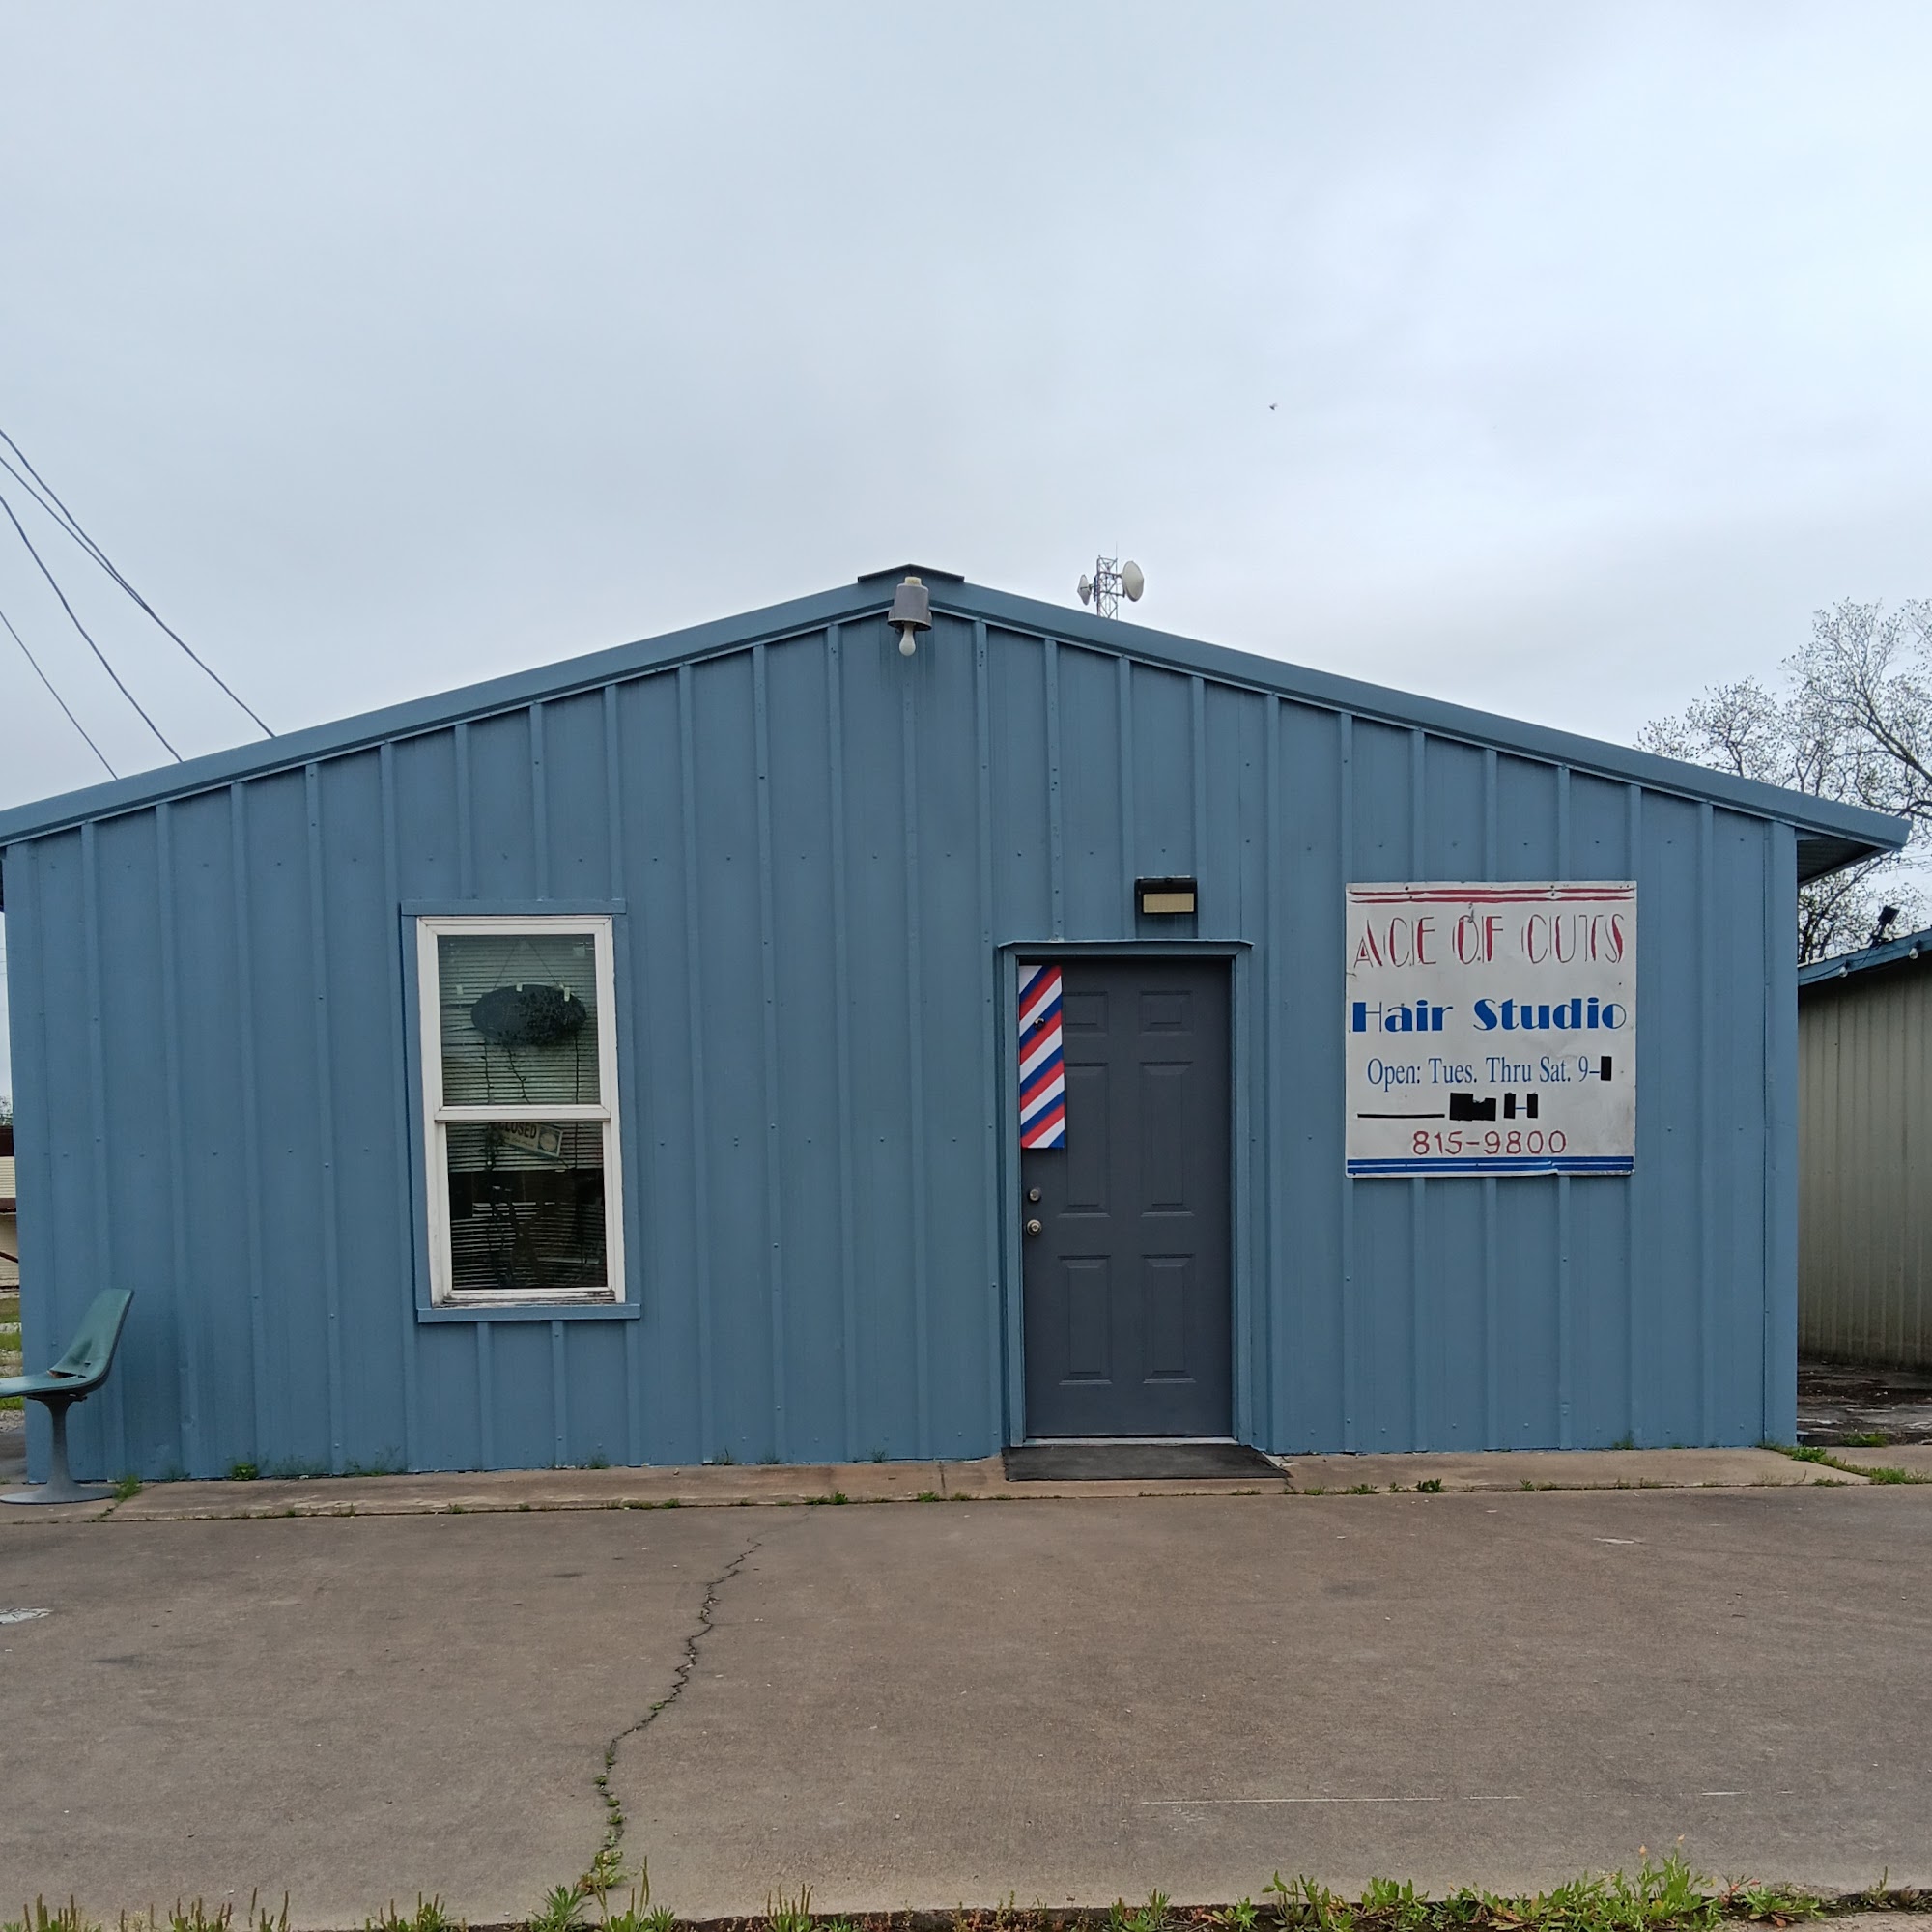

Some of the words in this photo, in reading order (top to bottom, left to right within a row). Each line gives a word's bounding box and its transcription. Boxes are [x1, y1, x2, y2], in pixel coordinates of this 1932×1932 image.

[1354, 917, 1437, 968] ACE
[1452, 915, 1504, 965] OF
[1521, 913, 1625, 964] CUTS
[1352, 1000, 1454, 1033] Hair
[1473, 997, 1627, 1031] Studio
[1367, 1058, 1421, 1092] Open:
[1428, 1058, 1478, 1084] Tues.
[1486, 1056, 1532, 1082] Thru
[1539, 1056, 1571, 1082] Sat.
[1578, 1056, 1609, 1081] 9-
[1412, 1130, 1567, 1155] 815-9800
